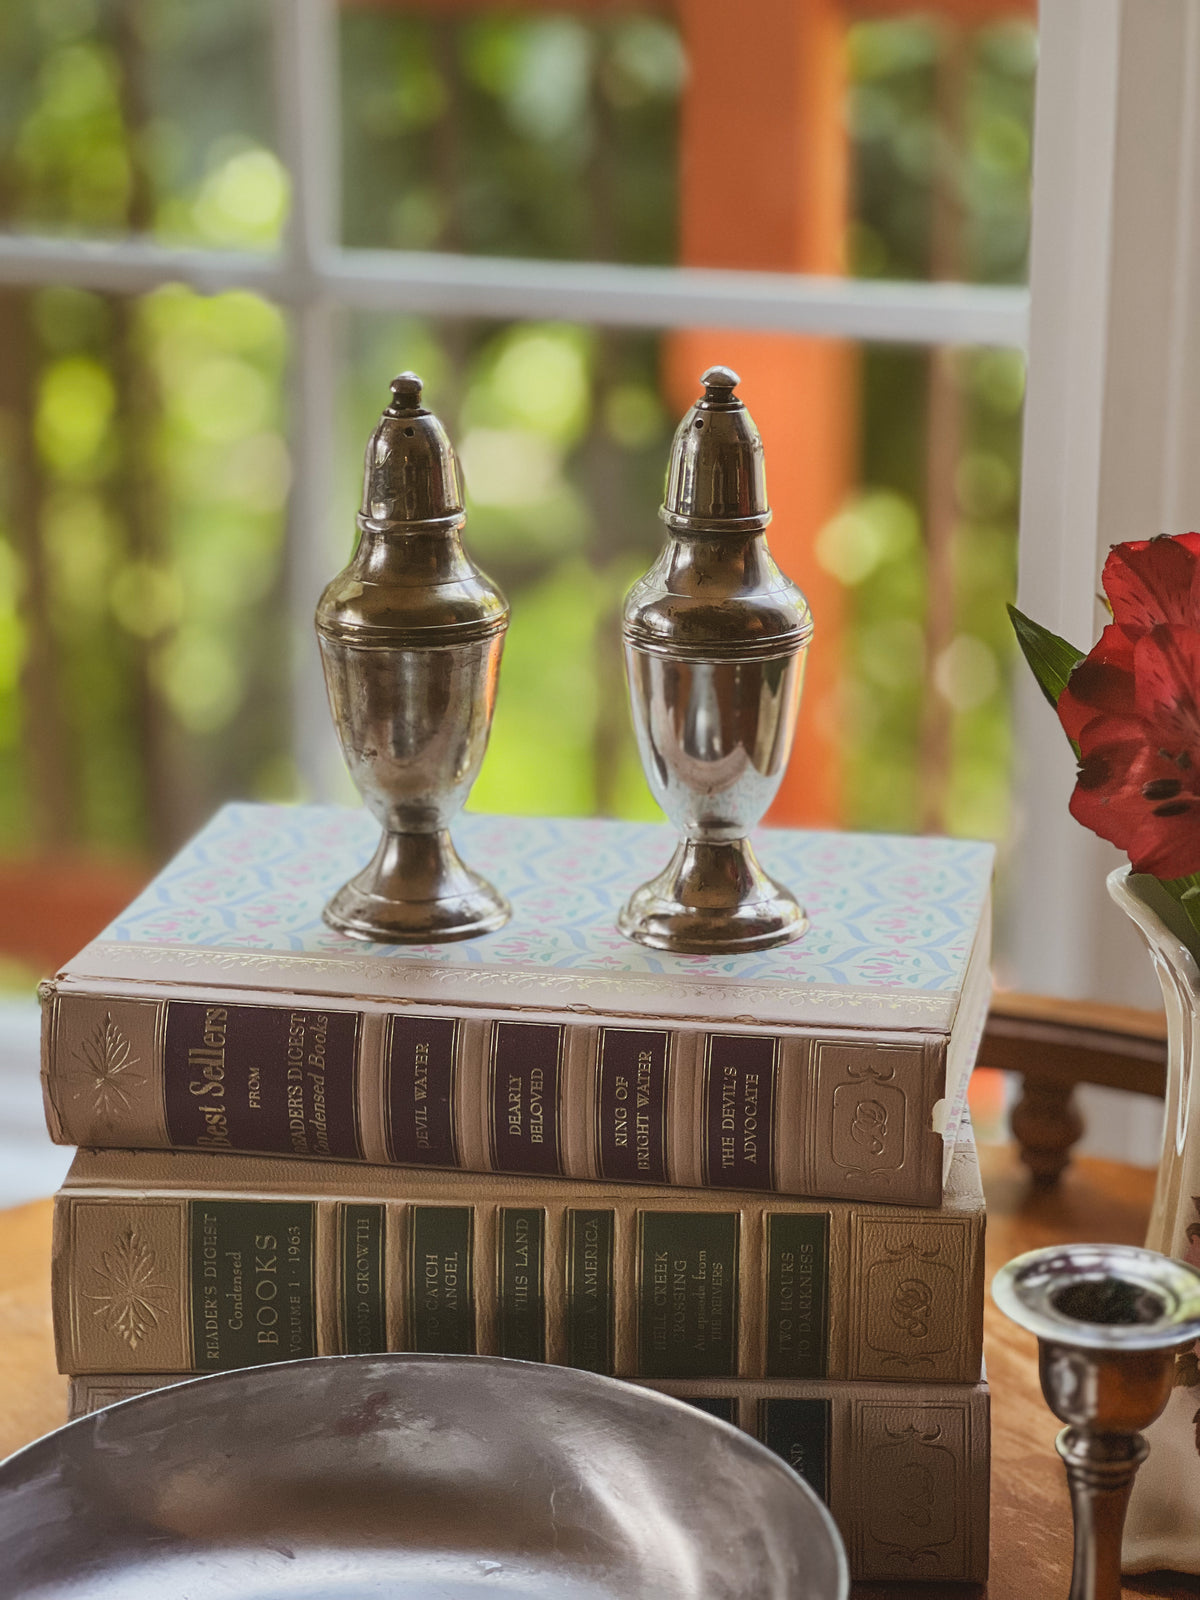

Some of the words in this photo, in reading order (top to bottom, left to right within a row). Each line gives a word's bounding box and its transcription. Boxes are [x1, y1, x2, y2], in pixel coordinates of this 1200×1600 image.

[188, 1008, 228, 1097] Sellers
[287, 1013, 306, 1081] DIGEST
[308, 1015, 329, 1071] Books
[414, 1042, 429, 1100] WATER
[248, 1066, 261, 1110] FROM
[508, 1074, 522, 1136] DEARLY
[530, 1068, 544, 1144] BELOVED
[615, 1075, 629, 1101] OF
[636, 1050, 652, 1108] WATER
[722, 1066, 737, 1131] DEVIL'S
[197, 1104, 232, 1148] Best
[287, 1085, 308, 1154] READER'S
[307, 1072, 331, 1156] Condensed
[414, 1106, 431, 1150] DEVIL
[615, 1107, 628, 1147] RING
[636, 1112, 650, 1170] BRIGHT
[744, 1073, 759, 1165] ADVOCATE
[721, 1137, 735, 1168] THE
[203, 1213, 217, 1278] DIGEST
[288, 1226, 301, 1262] 1963
[356, 1219, 370, 1295] GROWTH
[515, 1218, 529, 1268] LAND
[584, 1219, 599, 1298] AMERICA
[692, 1250, 707, 1280] from
[225, 1250, 243, 1330] Condensed
[255, 1235, 279, 1345] BOOKS
[288, 1281, 300, 1289] 1
[425, 1254, 439, 1310] CATCH
[445, 1251, 458, 1310] ANGEL
[654, 1251, 669, 1306] CREEK
[673, 1259, 688, 1343] CROSSING
[711, 1262, 723, 1315] REIVERS
[780, 1252, 794, 1312] HOURS
[799, 1244, 814, 1333] DARKNESS
[204, 1286, 219, 1359] READER'S
[289, 1296, 303, 1352] VOLUME
[356, 1302, 371, 1354] ECOND
[711, 1320, 722, 1341] THE
[779, 1320, 793, 1353] TWO
[798, 1340, 811, 1361] TO
